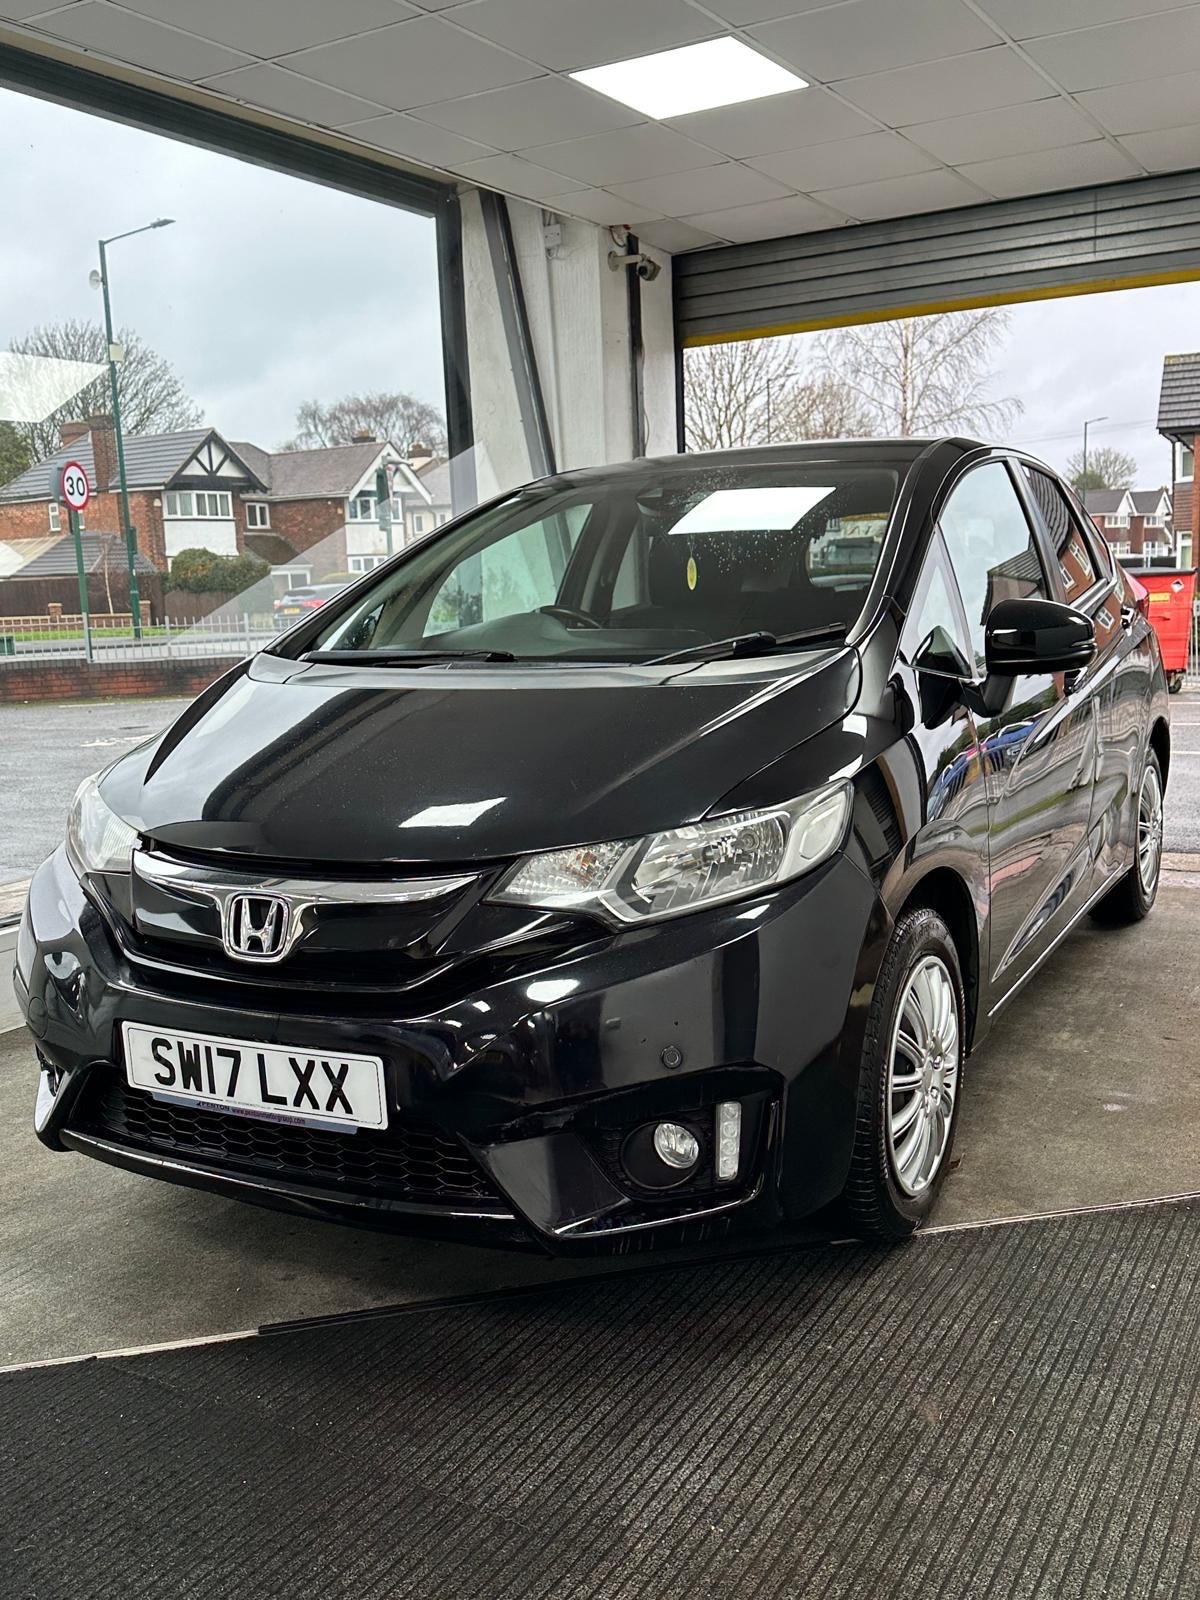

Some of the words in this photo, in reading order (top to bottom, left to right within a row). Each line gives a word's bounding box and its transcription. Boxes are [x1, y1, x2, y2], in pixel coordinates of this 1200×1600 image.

[66, 476, 85, 497] 30
[151, 1037, 242, 1098] SW17
[257, 1053, 354, 1115] LXX
